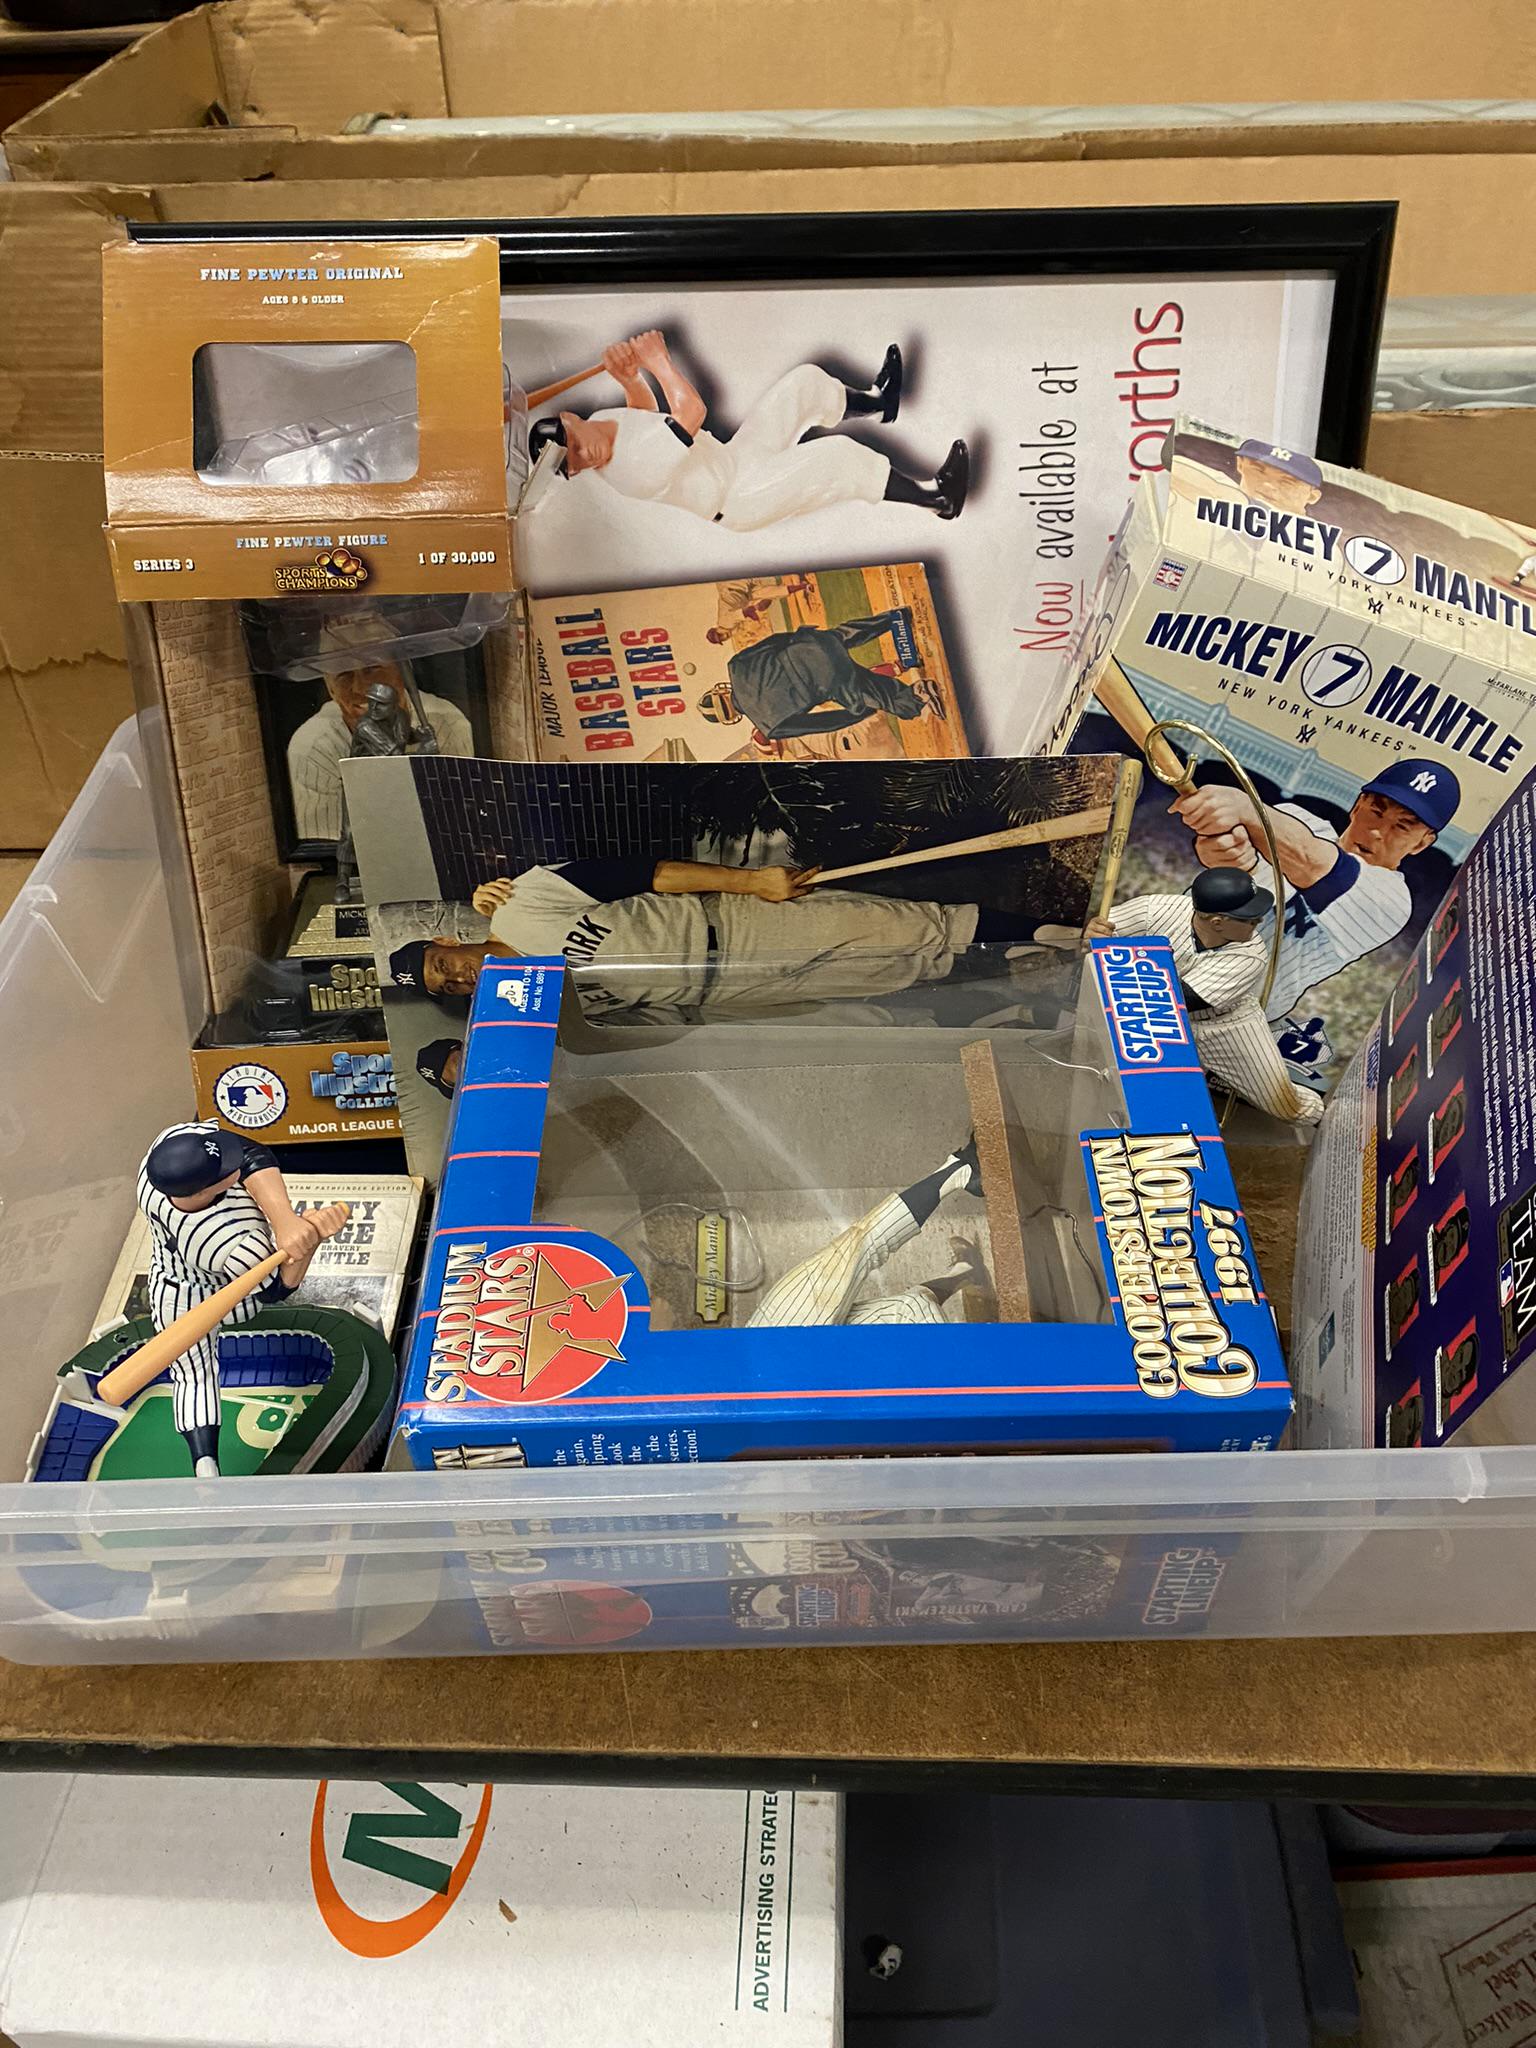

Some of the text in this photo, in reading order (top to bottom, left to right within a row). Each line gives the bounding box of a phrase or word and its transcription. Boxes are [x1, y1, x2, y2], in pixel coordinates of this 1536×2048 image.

[200, 266, 404, 281] FINE PEWTER ORIGINAL
[262, 294, 289, 305] AGES
[311, 293, 345, 305] OLDER
[1032, 361, 1079, 395] at
[1018, 417, 1079, 560] available
[236, 534, 389, 549] FINE PEWTER FIGURE
[1197, 498, 1341, 562] MICKEY
[1361, 541, 1393, 577] 7
[133, 558, 195, 572] SERIES 3
[275, 565, 329, 580] SPORTS
[419, 550, 496, 565] 1 OF 30,000
[1278, 552, 1314, 574] NEW
[1328, 571, 1373, 595] YORK
[275, 575, 358, 591] CHAMPIONS
[1011, 580, 1075, 652] Now
[893, 611, 912, 660] Hartland
[554, 607, 635, 753] BASEBALL
[619, 626, 686, 717] STARS
[1145, 612, 1524, 774] MICKEY 7 MANTLE
[1218, 678, 1255, 701] NEW
[1266, 695, 1313, 720] YORK
[541, 692, 566, 738] MAJOR
[534, 985, 544, 996] No.
[535, 966, 546, 985] 68910
[1106, 945, 1160, 1063] STARTING
[221, 1066, 276, 1087] GENUINE
[226, 1103, 281, 1126] MERCHANDISE
[289, 1119, 395, 1135] MAJOR LEAGUE
[1509, 1105, 1517, 1129] 1999
[1493, 1094, 1502, 1128] players
[1498, 1163, 1506, 1200] selected
[1510, 1125, 1518, 1156] World
[1519, 1119, 1529, 1152] Major
[1511, 1153, 1520, 1186] Series.
[1488, 1168, 1496, 1207] Baseball
[704, 1219, 722, 1312] Mickey Mantle
[1090, 1134, 1180, 1400] COOPERSTOWN
[1127, 1131, 1258, 1398] COLLECTION
[1201, 1201, 1260, 1307] 1997
[1511, 1198, 1536, 1335] TEAM
[424, 1241, 488, 1404] STADIUM
[553, 1449, 567, 1465] the
[570, 1439, 588, 1466] gain,
[589, 1433, 608, 1465] lpting
[629, 1445, 641, 1462] the
[647, 1435, 659, 1452] the
[665, 1429, 679, 1462] series.
[683, 1429, 698, 1463] ection!
[1143, 1547, 1201, 1625] STARTING
[1178, 1556, 1225, 1614] LINEUP
[752, 1873, 774, 2013] ADVERTISING
